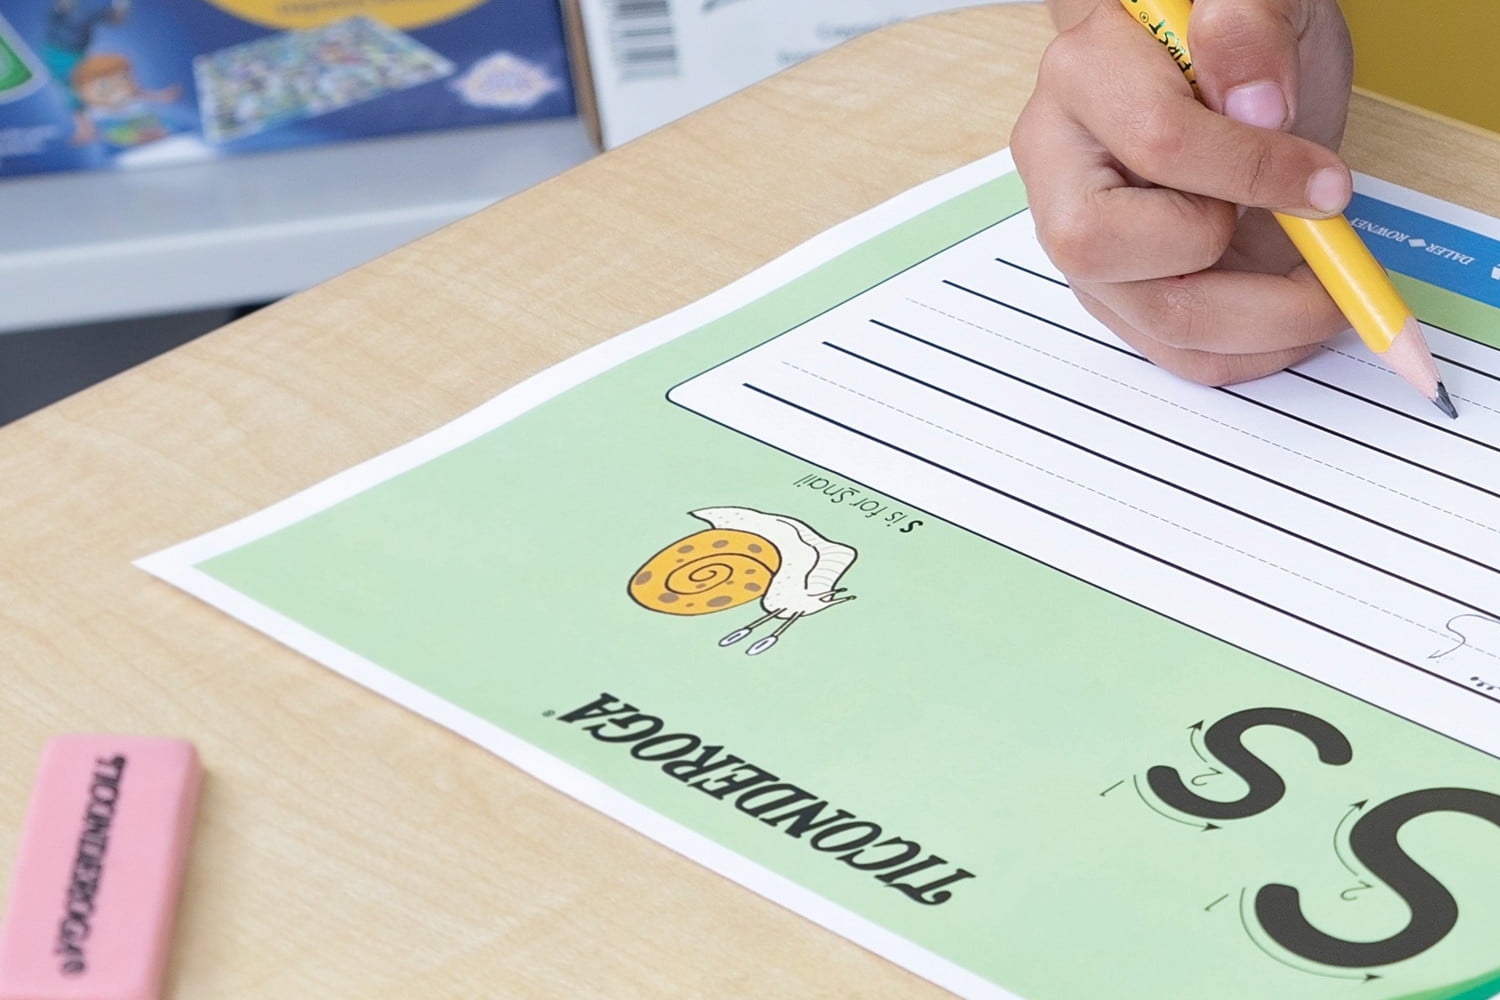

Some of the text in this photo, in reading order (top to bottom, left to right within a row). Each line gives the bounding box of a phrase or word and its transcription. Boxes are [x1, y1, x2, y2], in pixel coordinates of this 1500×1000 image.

[1149, 19, 1192, 72] FIRST
[1426, 243, 1475, 265] DALER
[849, 498, 888, 519] for
[885, 511, 908, 527] is
[556, 692, 977, 906] TICONDEROGA
